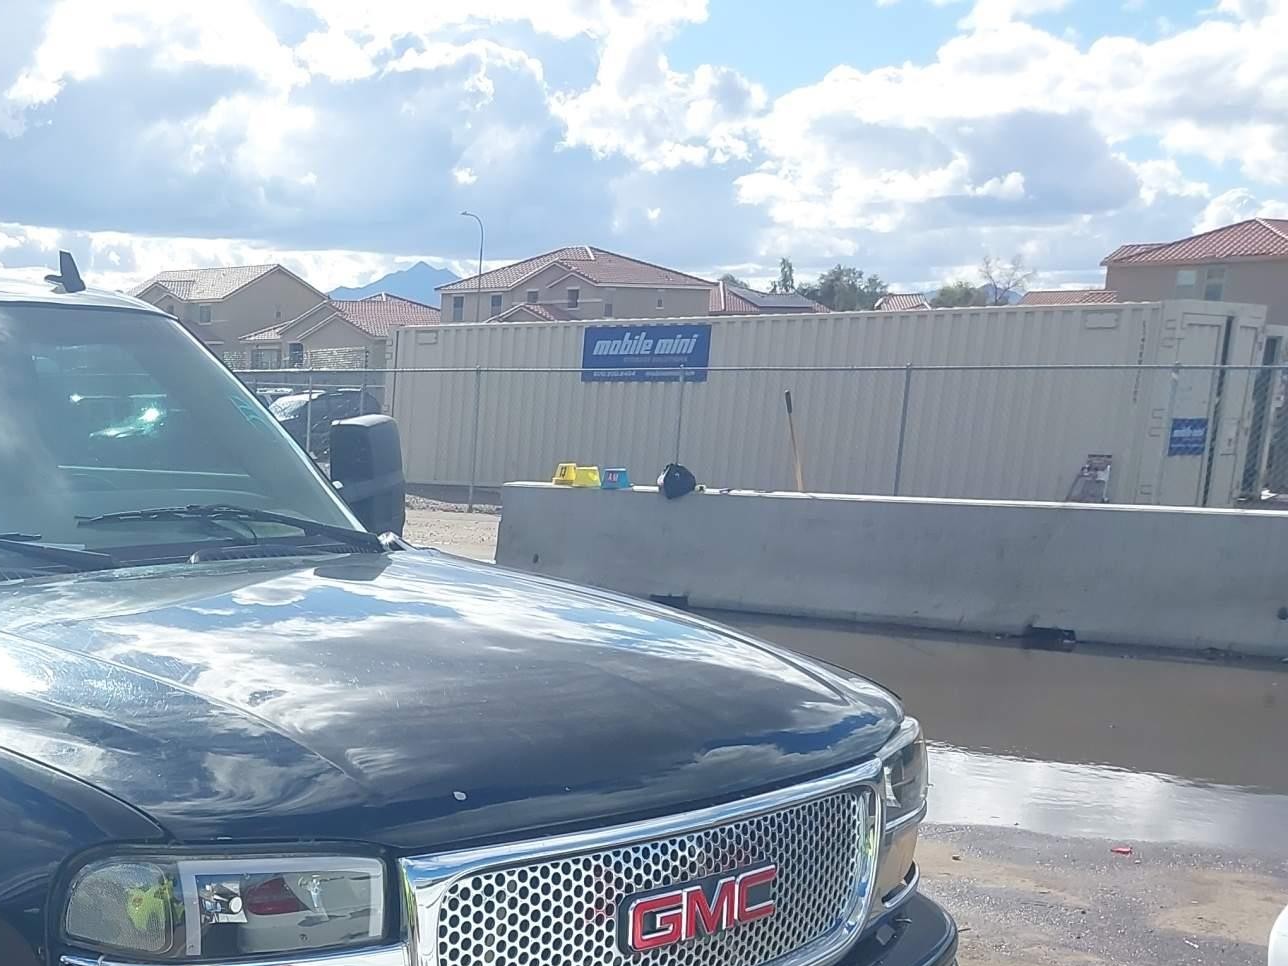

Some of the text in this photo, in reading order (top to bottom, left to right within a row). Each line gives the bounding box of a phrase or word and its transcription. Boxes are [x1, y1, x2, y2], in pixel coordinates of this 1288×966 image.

[592, 332, 699, 355] mobile mini
[628, 864, 777, 951] GMC
